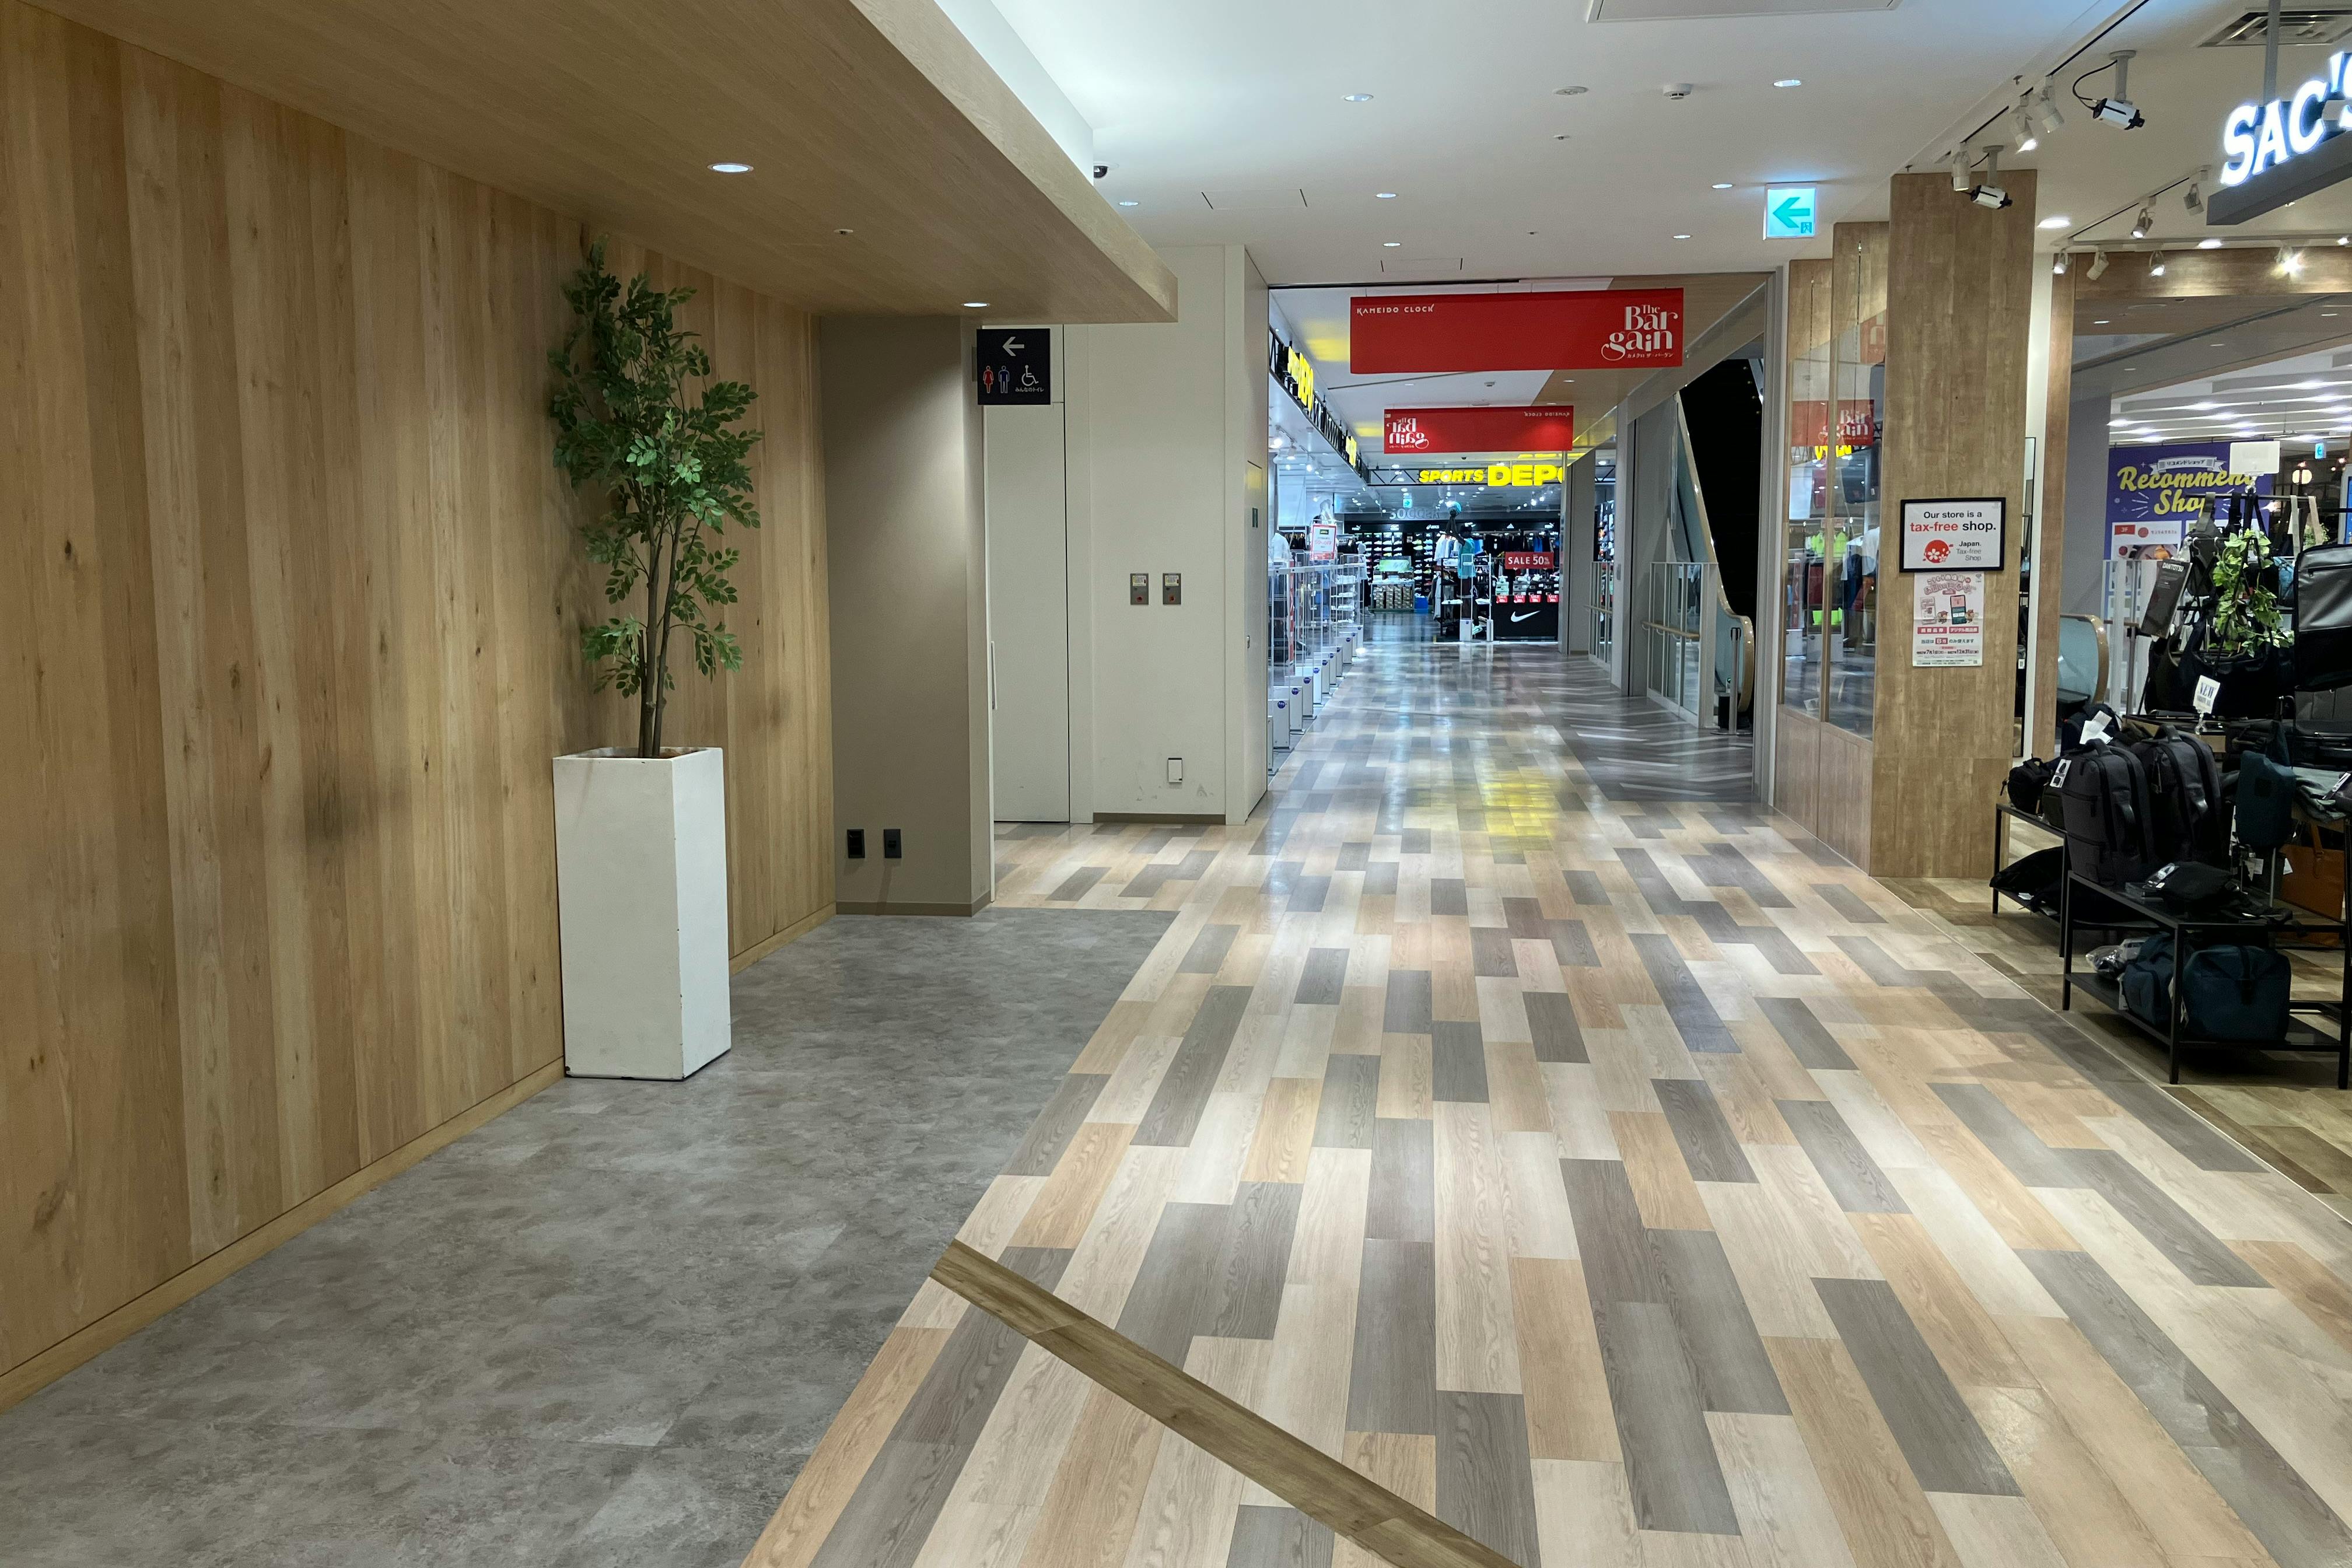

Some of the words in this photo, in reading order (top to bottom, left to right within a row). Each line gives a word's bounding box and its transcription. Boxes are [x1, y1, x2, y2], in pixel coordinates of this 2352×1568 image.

[1357, 307, 1399, 316] KAMEIDO
[1404, 303, 1434, 313] CLOCK
[1642, 304, 1661, 314] The
[1625, 306, 1678, 330] Bar
[1601, 331, 1672, 361] gain
[1418, 469, 1485, 483] SPORTS
[1488, 464, 1563, 487] DEP
[1389, 508, 1440, 520] SOCCER
[1910, 522, 1958, 532] tax-free
[1962, 521, 1997, 532] shop.
[1508, 556, 1530, 565] SALE
[2200, 682, 2217, 699] NEW
